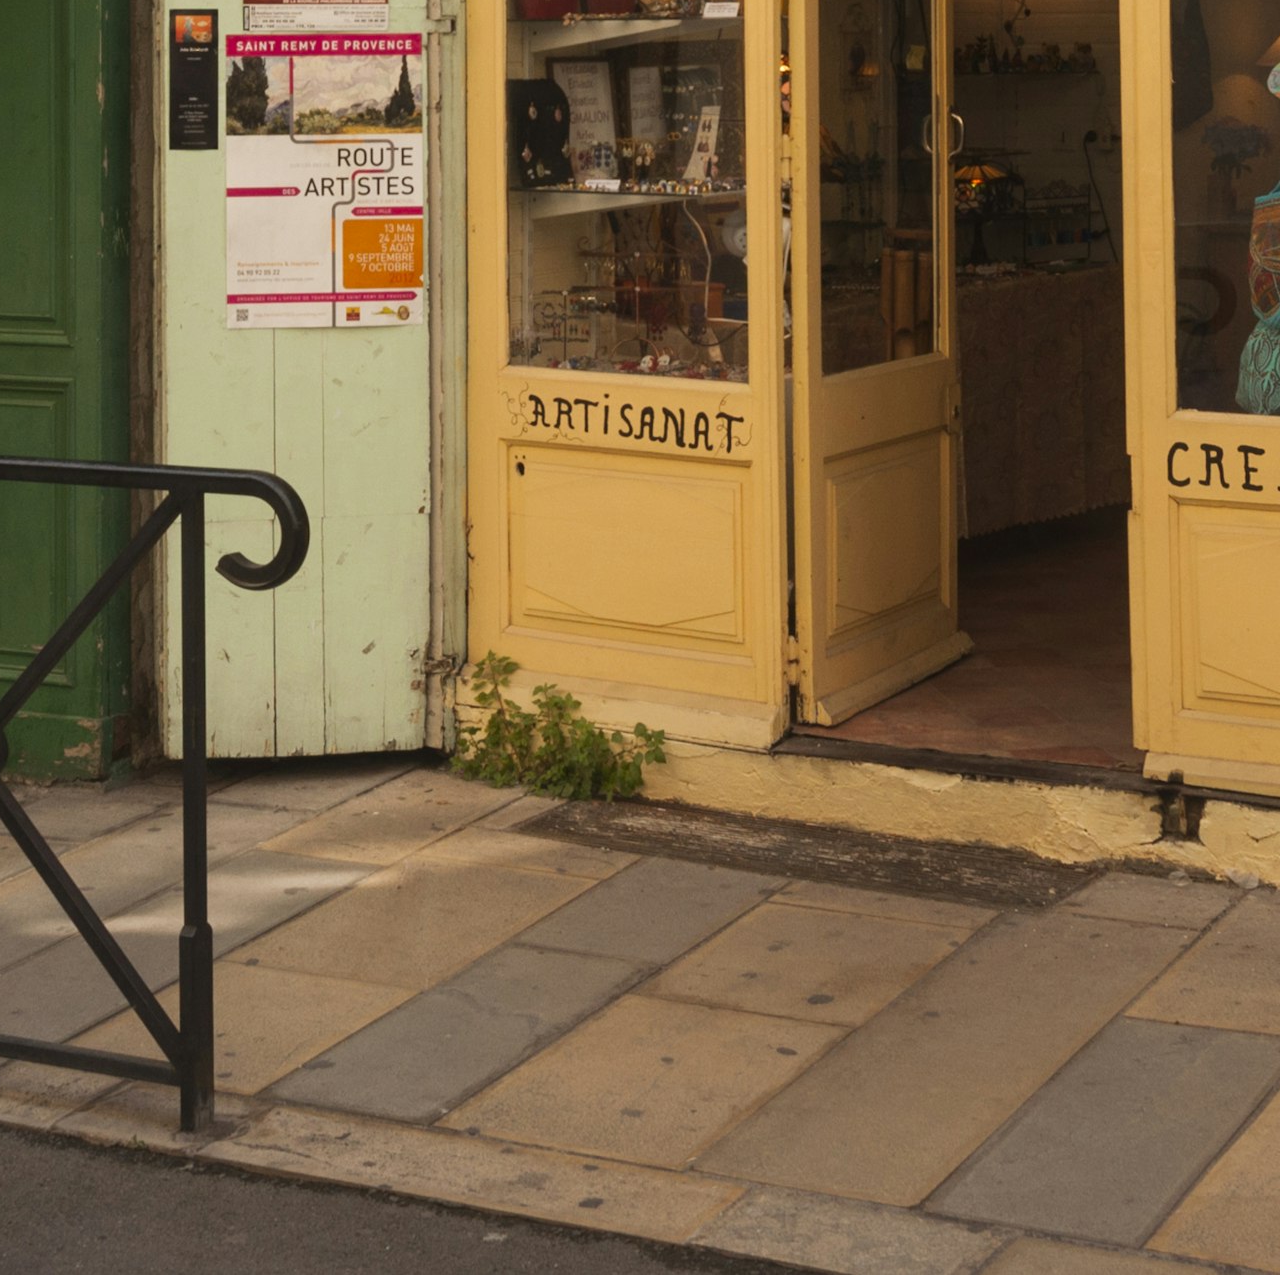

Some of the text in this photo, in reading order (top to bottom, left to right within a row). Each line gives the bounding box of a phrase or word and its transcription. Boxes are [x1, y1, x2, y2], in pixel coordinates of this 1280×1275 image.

[281, 40, 317, 51] REMY
[322, 40, 338, 51] DE
[344, 39, 413, 51] PROVENCE
[338, 147, 414, 167] ROUTE
[282, 187, 296, 196] DES
[384, 223, 394, 233] 13
[379, 233, 390, 244] 24
[381, 243, 388, 253] 5
[348, 252, 415, 263] 9 SEPTEMBRE
[360, 262, 415, 273] 7 OCTOBRE
[389, 272, 415, 284] 2012
